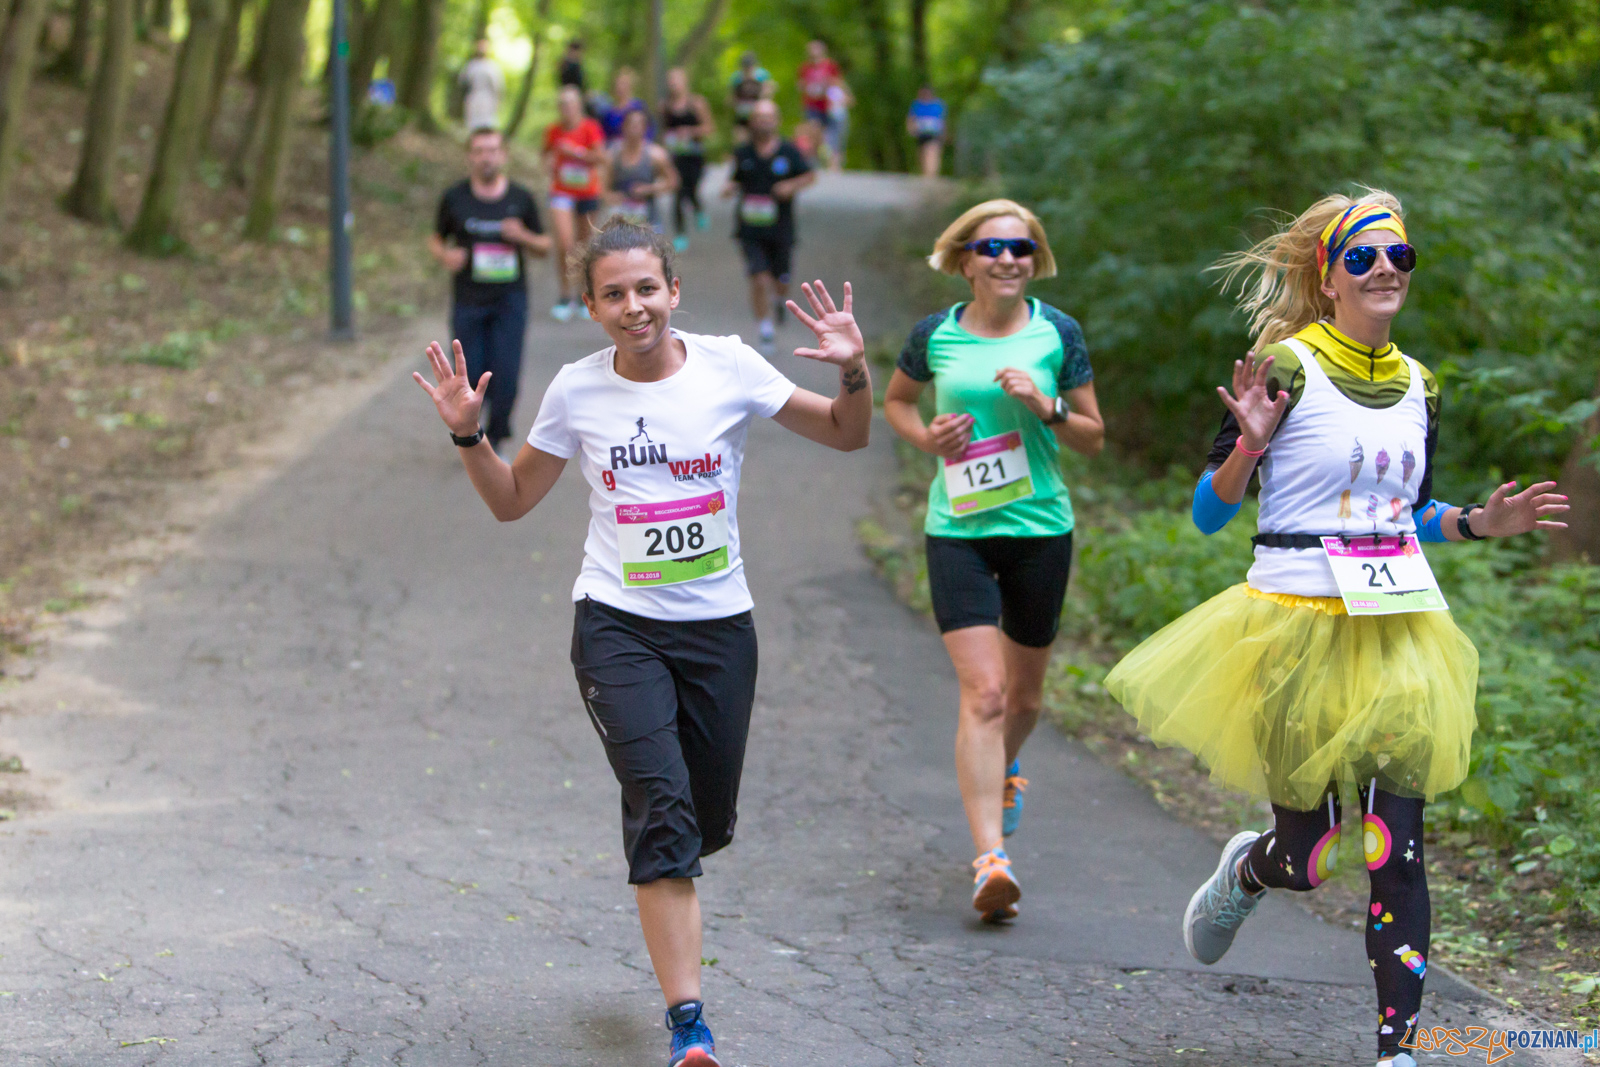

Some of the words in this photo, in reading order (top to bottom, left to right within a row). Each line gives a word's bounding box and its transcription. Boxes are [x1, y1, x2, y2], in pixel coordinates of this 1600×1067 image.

[610, 443, 668, 470] RUN
[602, 470, 616, 491] g
[668, 453, 721, 476] wald
[673, 474, 694, 482] TEAM
[963, 457, 1006, 487] 121
[644, 522, 704, 556] 208
[1362, 563, 1396, 587] 21
